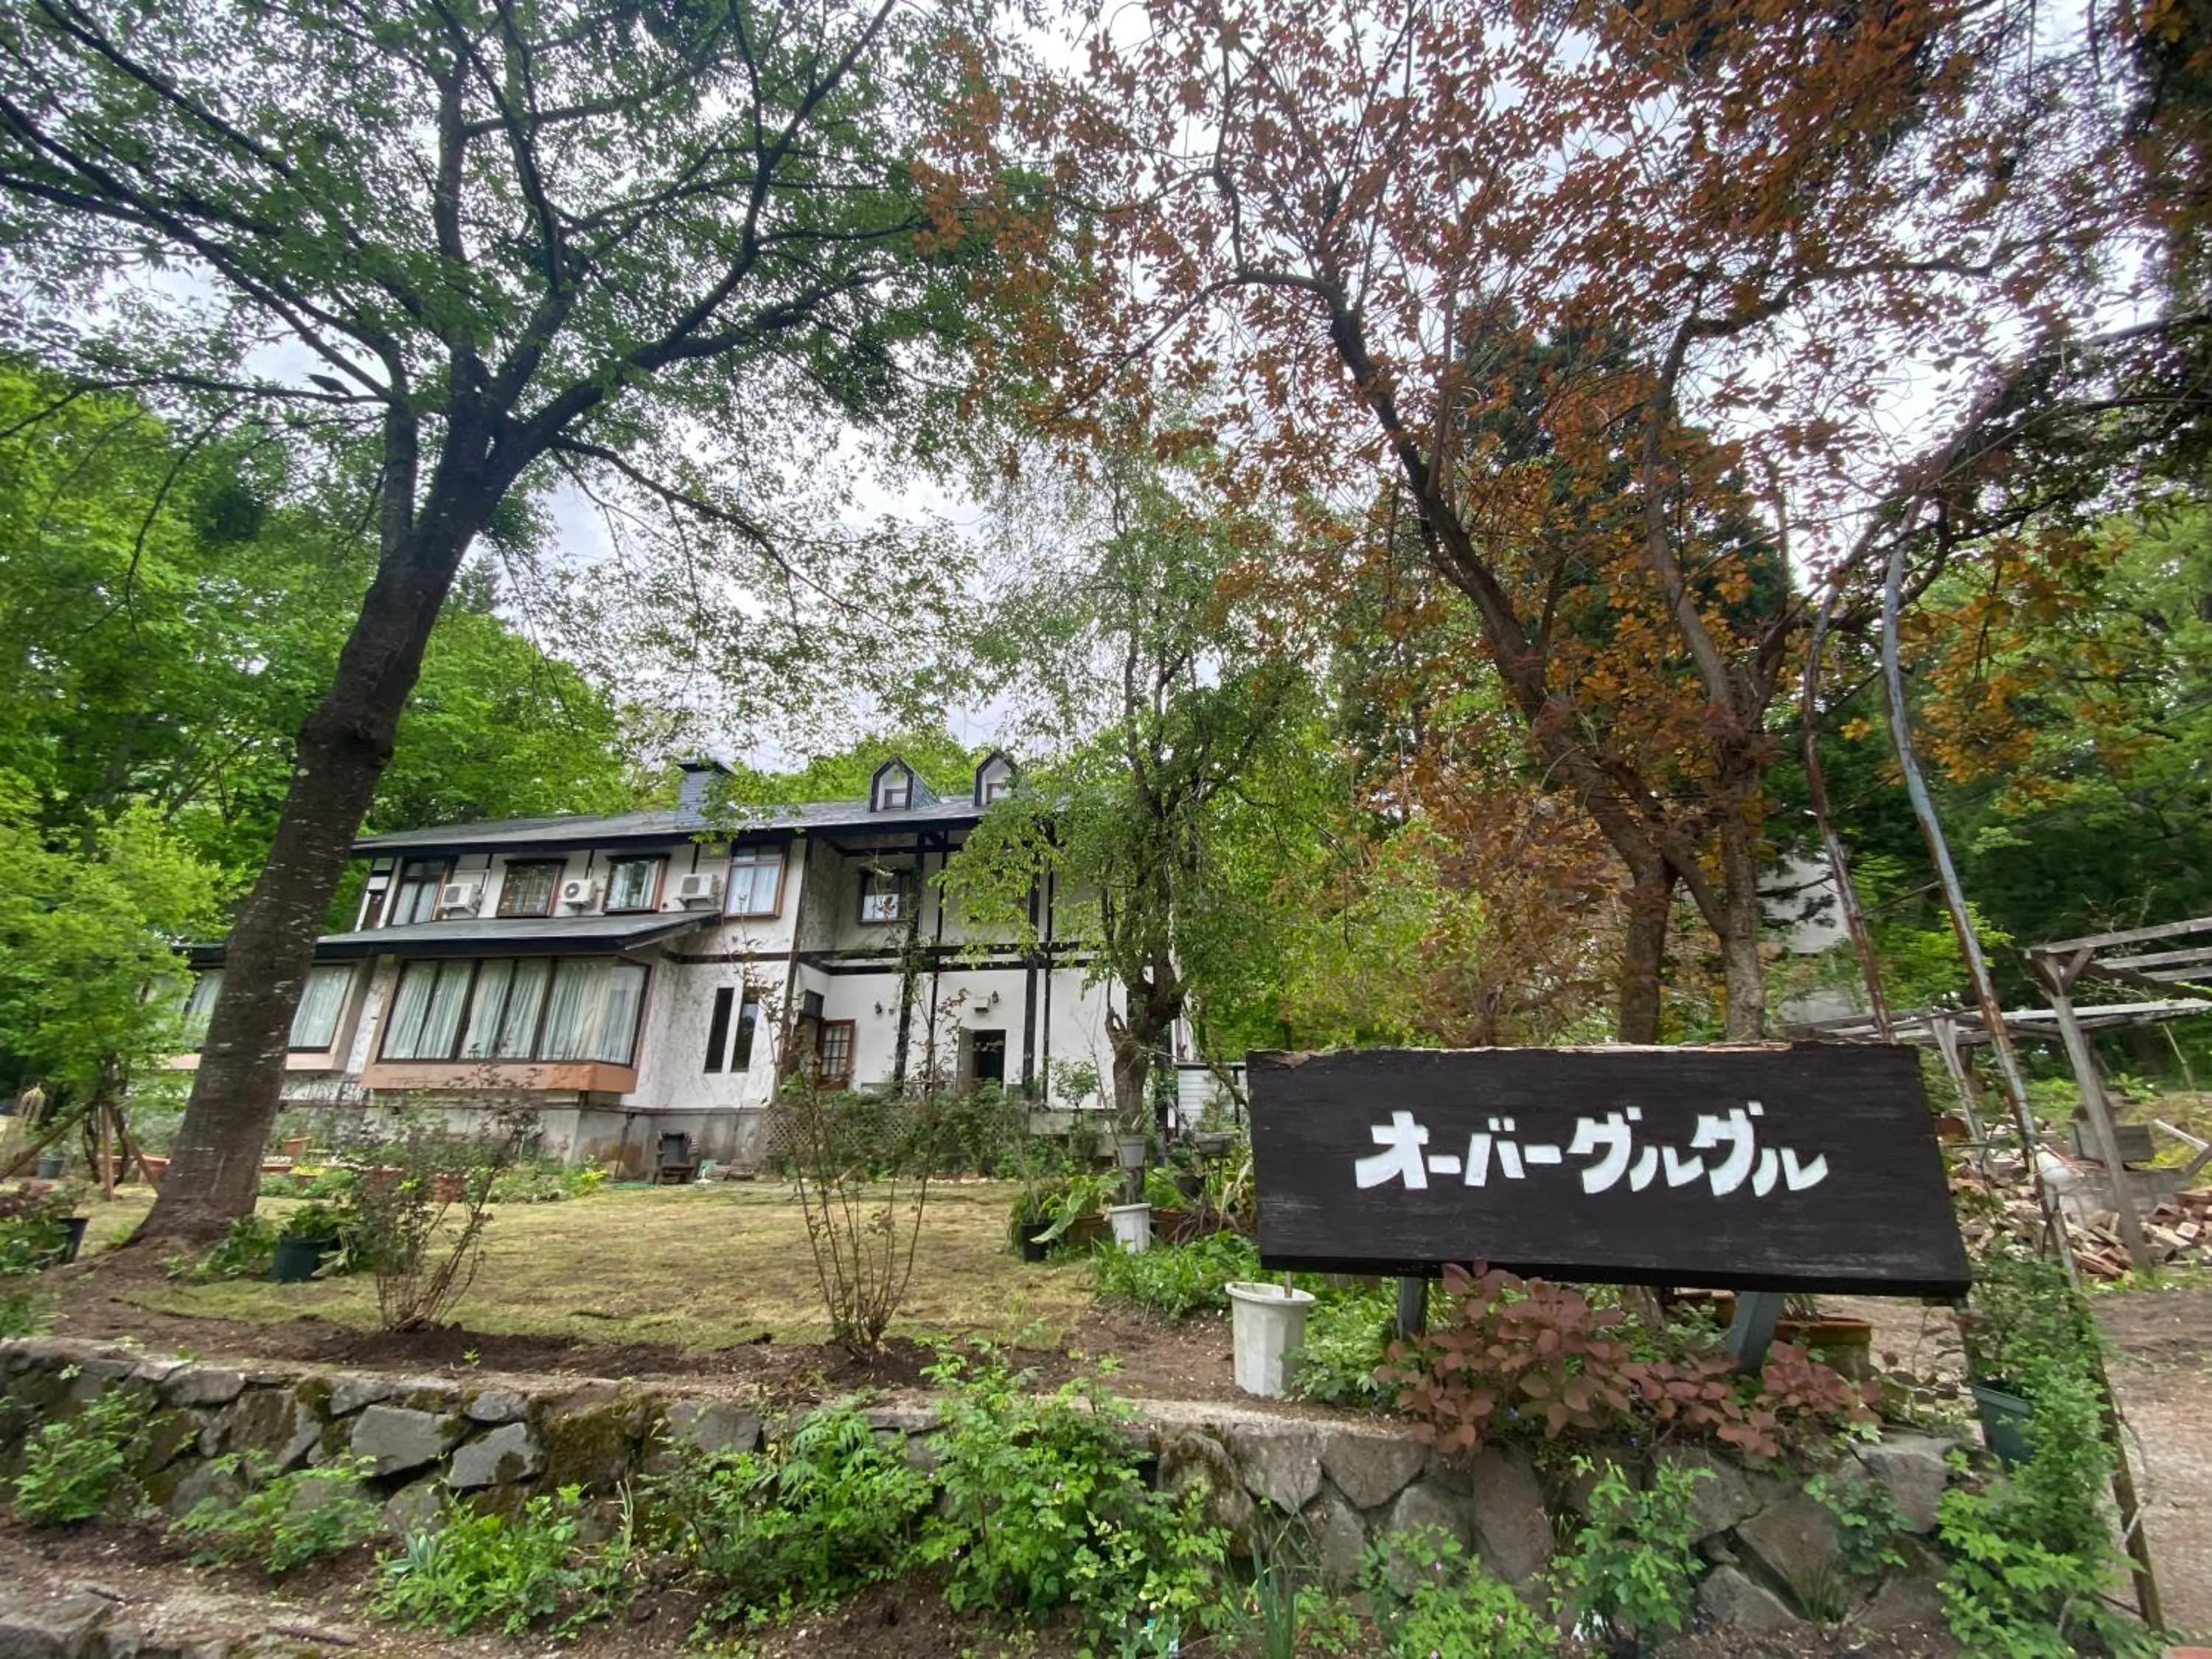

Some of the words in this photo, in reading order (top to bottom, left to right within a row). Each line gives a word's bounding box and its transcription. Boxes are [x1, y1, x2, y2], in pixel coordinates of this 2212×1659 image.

[1354, 1102, 1829, 1197] オーバーグルグル
